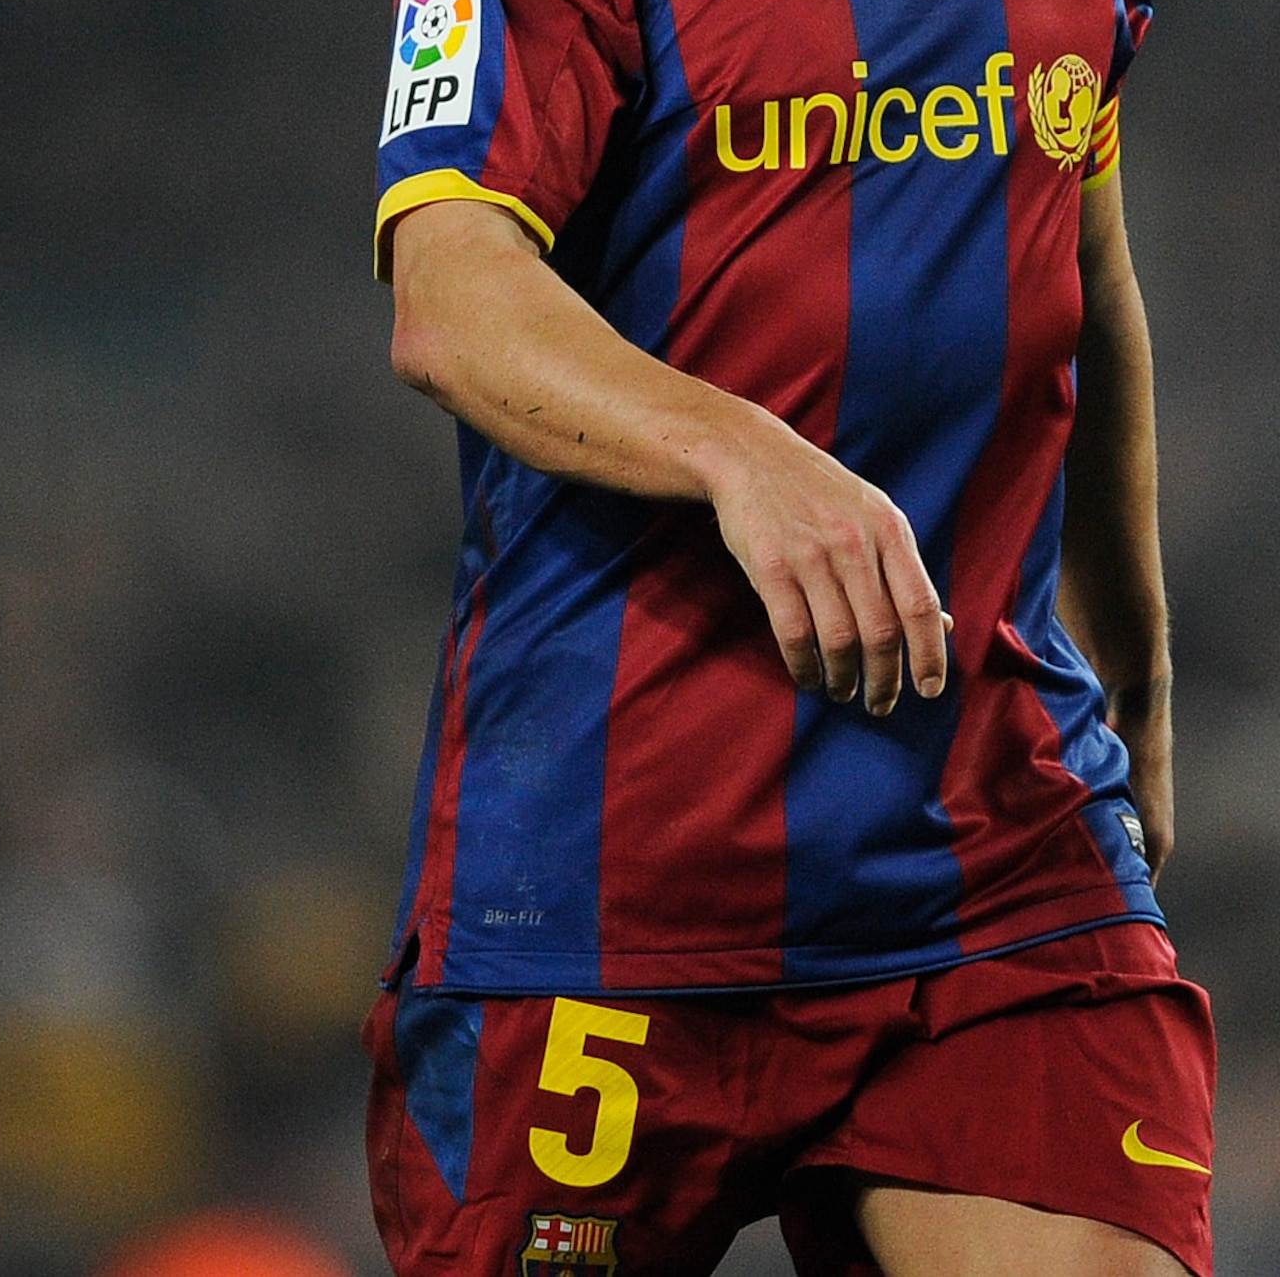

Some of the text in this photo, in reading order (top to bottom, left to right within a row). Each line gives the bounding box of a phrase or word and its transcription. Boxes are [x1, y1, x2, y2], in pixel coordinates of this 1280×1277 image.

[388, 75, 459, 136] LFP
[716, 52, 1014, 172] unicef
[483, 909, 546, 926] DRI-FIT
[529, 996, 651, 1188] 5
